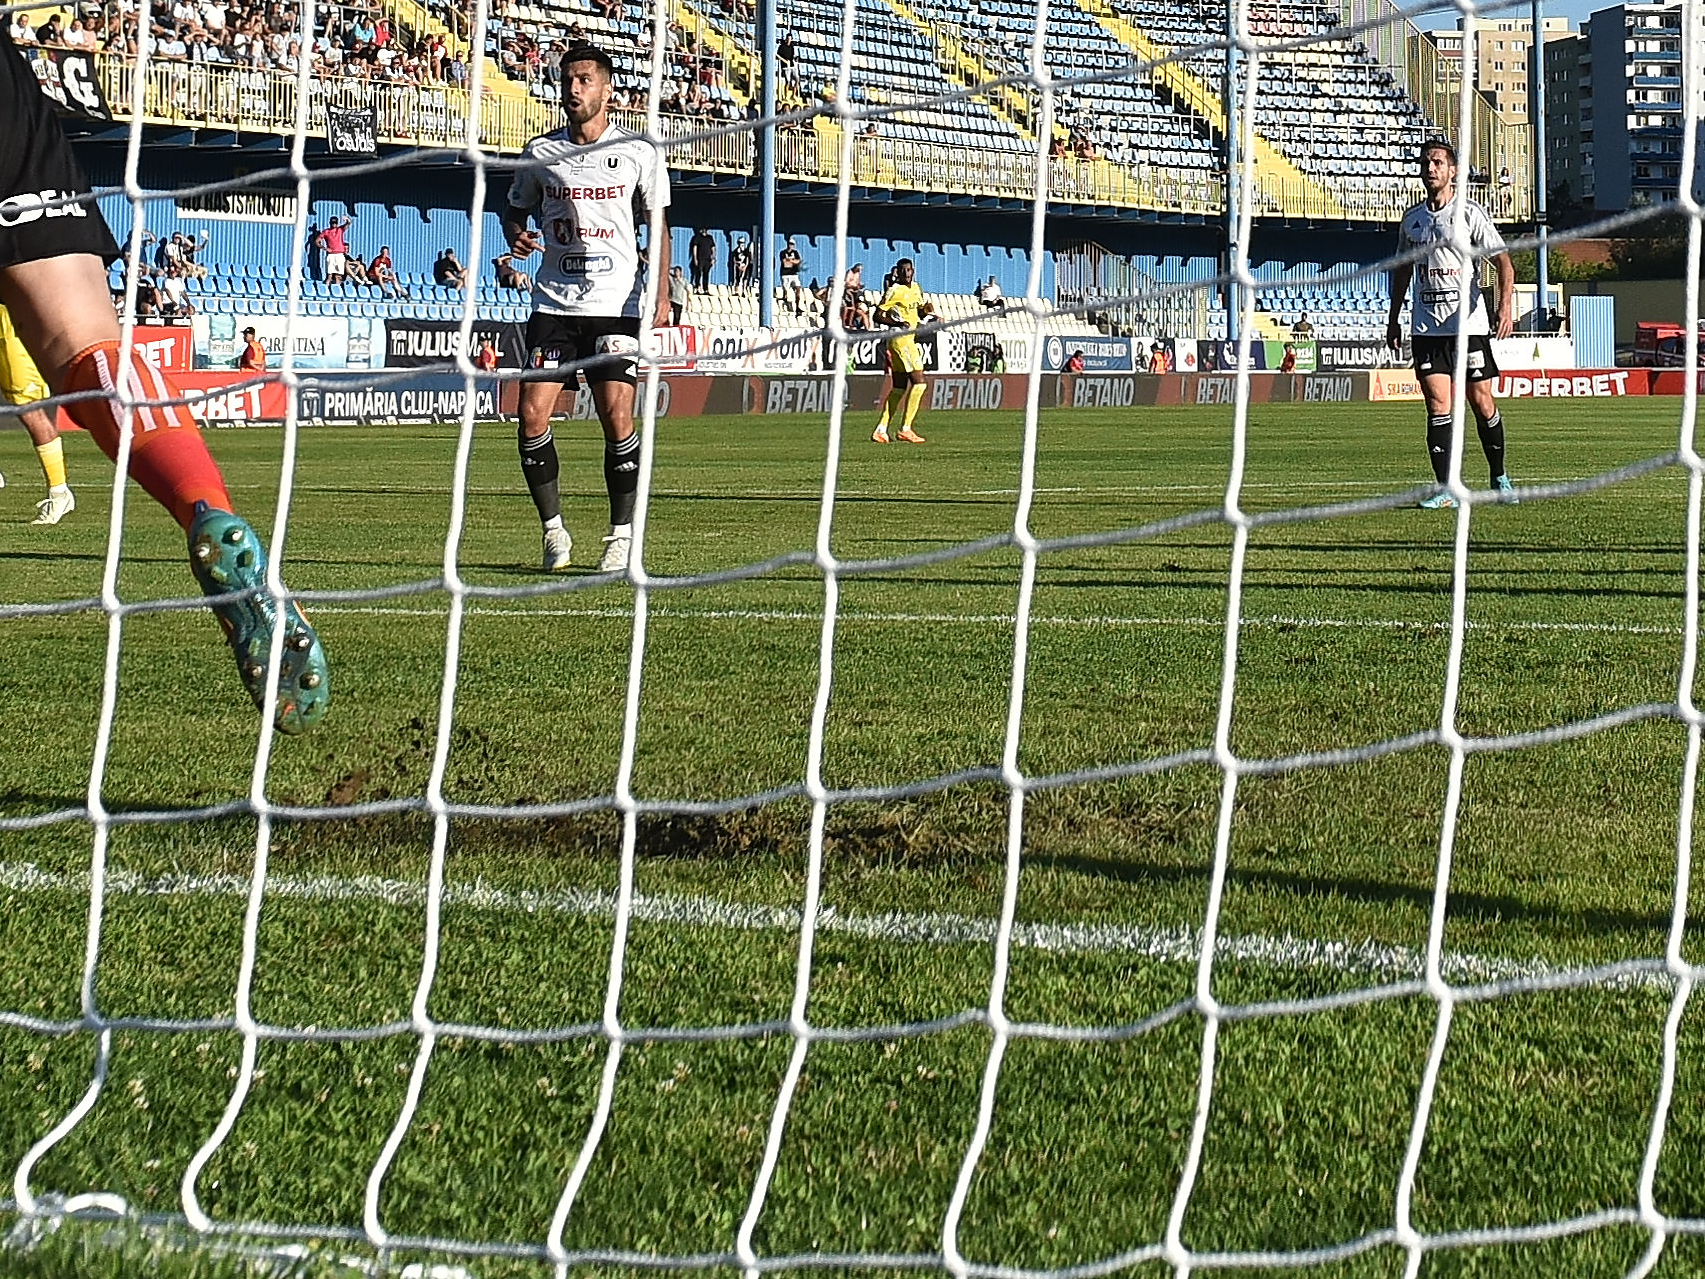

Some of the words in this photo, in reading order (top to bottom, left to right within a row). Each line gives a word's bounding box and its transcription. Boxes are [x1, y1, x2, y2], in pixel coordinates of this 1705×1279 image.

[545, 184, 626, 201] SUPERBET
[324, 386, 398, 418] PRIMĂRIA
[401, 389, 494, 417] CLUJ-NAPCA
[930, 378, 1003, 411] BETANO
[1073, 377, 1135, 407] BETANO
[1303, 376, 1353, 402] BETANO
